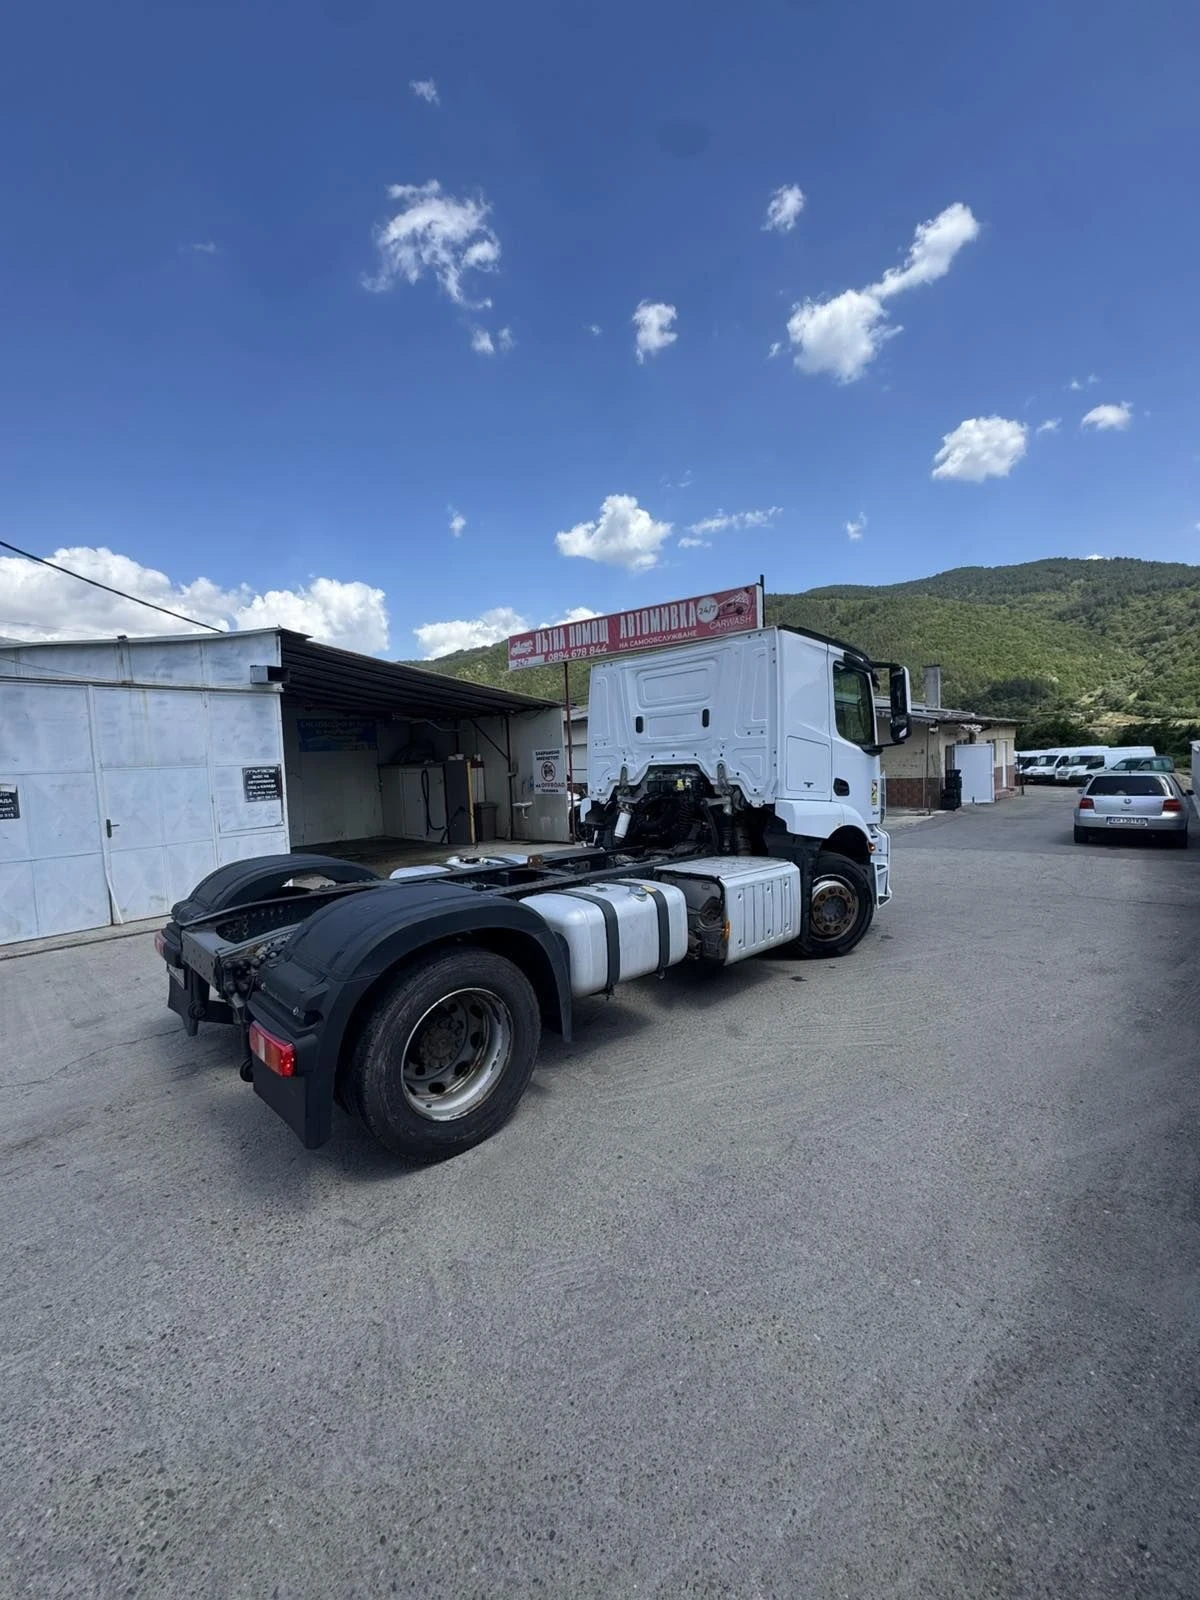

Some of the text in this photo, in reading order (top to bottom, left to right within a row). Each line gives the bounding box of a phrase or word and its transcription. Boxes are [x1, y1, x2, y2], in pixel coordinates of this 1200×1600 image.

[698, 605, 717, 615] 24/7
[620, 601, 697, 640] АВТОМИВКА
[709, 615, 752, 631] CARWASH
[535, 619, 609, 655] ПЪТНА ПОМОЩ
[548, 644, 608, 662] 0894 678 844
